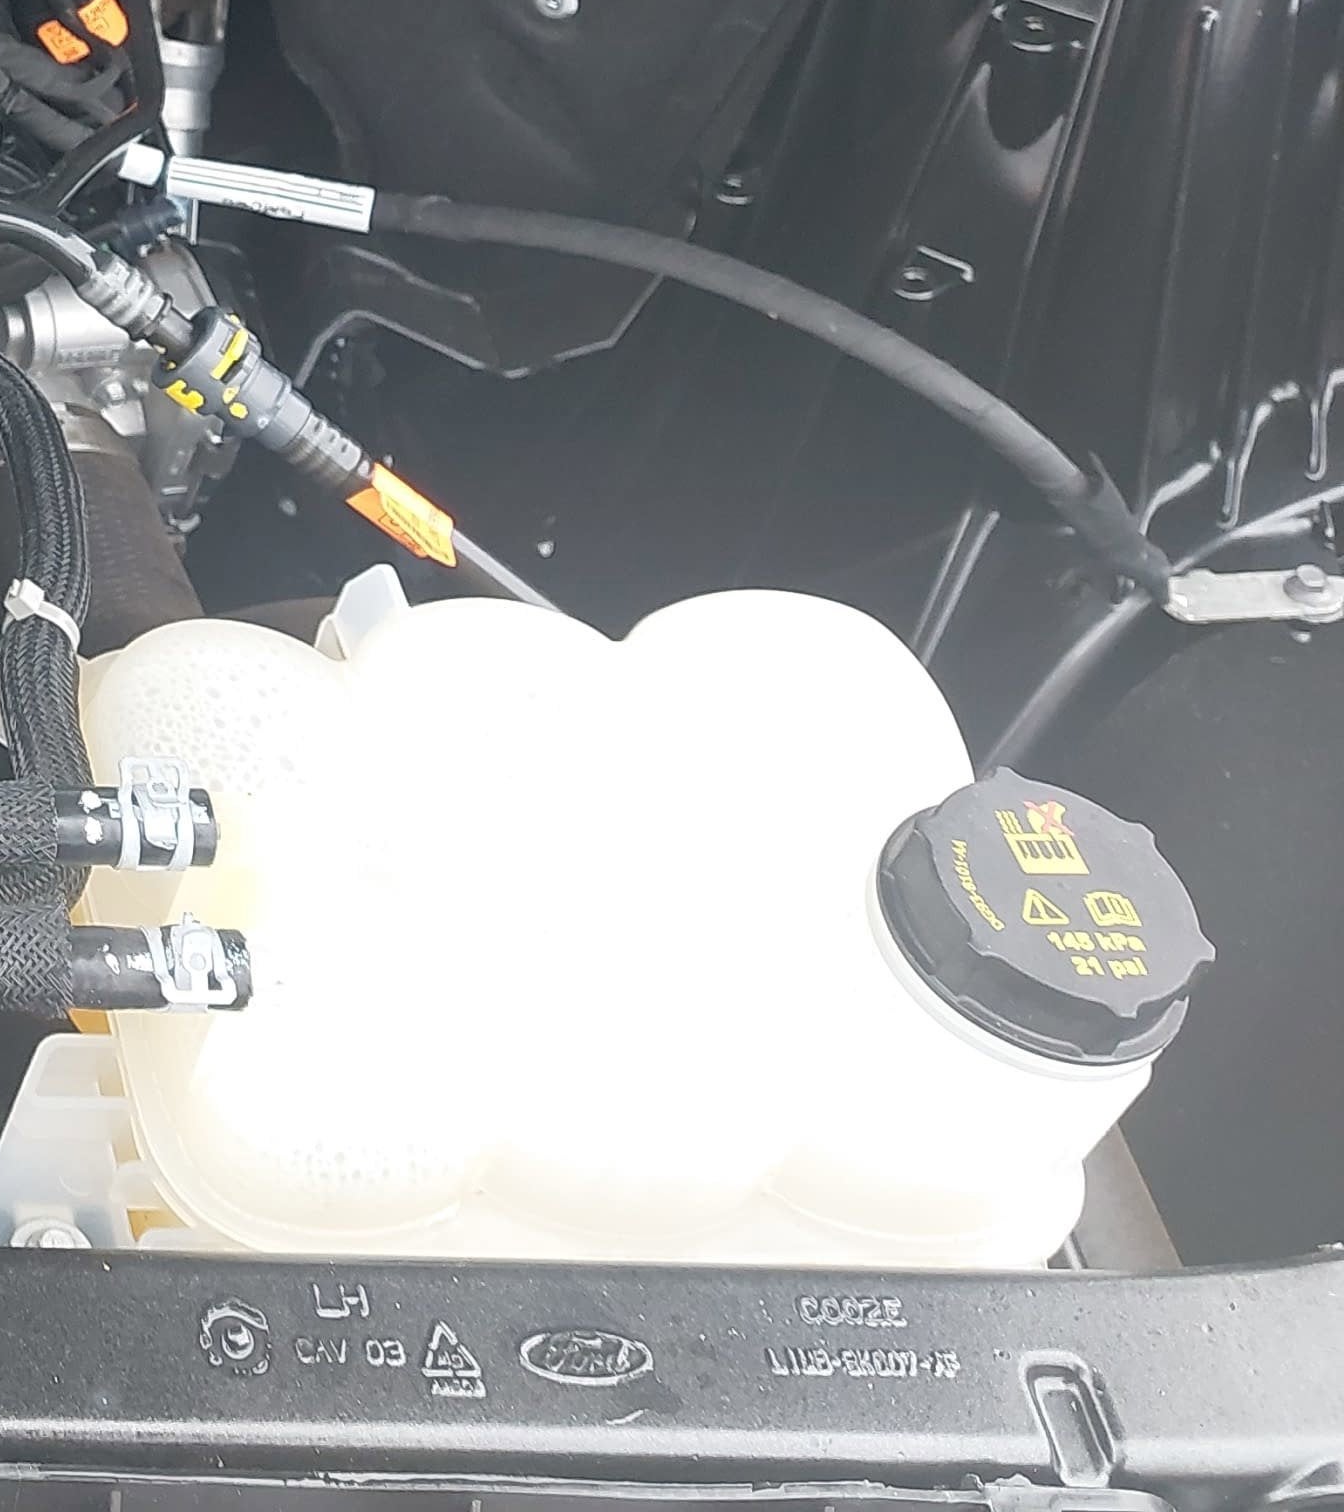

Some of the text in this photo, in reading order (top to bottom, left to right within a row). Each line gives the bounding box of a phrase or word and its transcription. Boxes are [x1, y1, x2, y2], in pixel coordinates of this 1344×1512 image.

[1094, 931, 1147, 952] kPa
[1070, 955, 1148, 980] 21 psi
[312, 1284, 370, 1318] LH
[295, 1338, 347, 1365] CAV
[366, 1338, 407, 1367] 03
